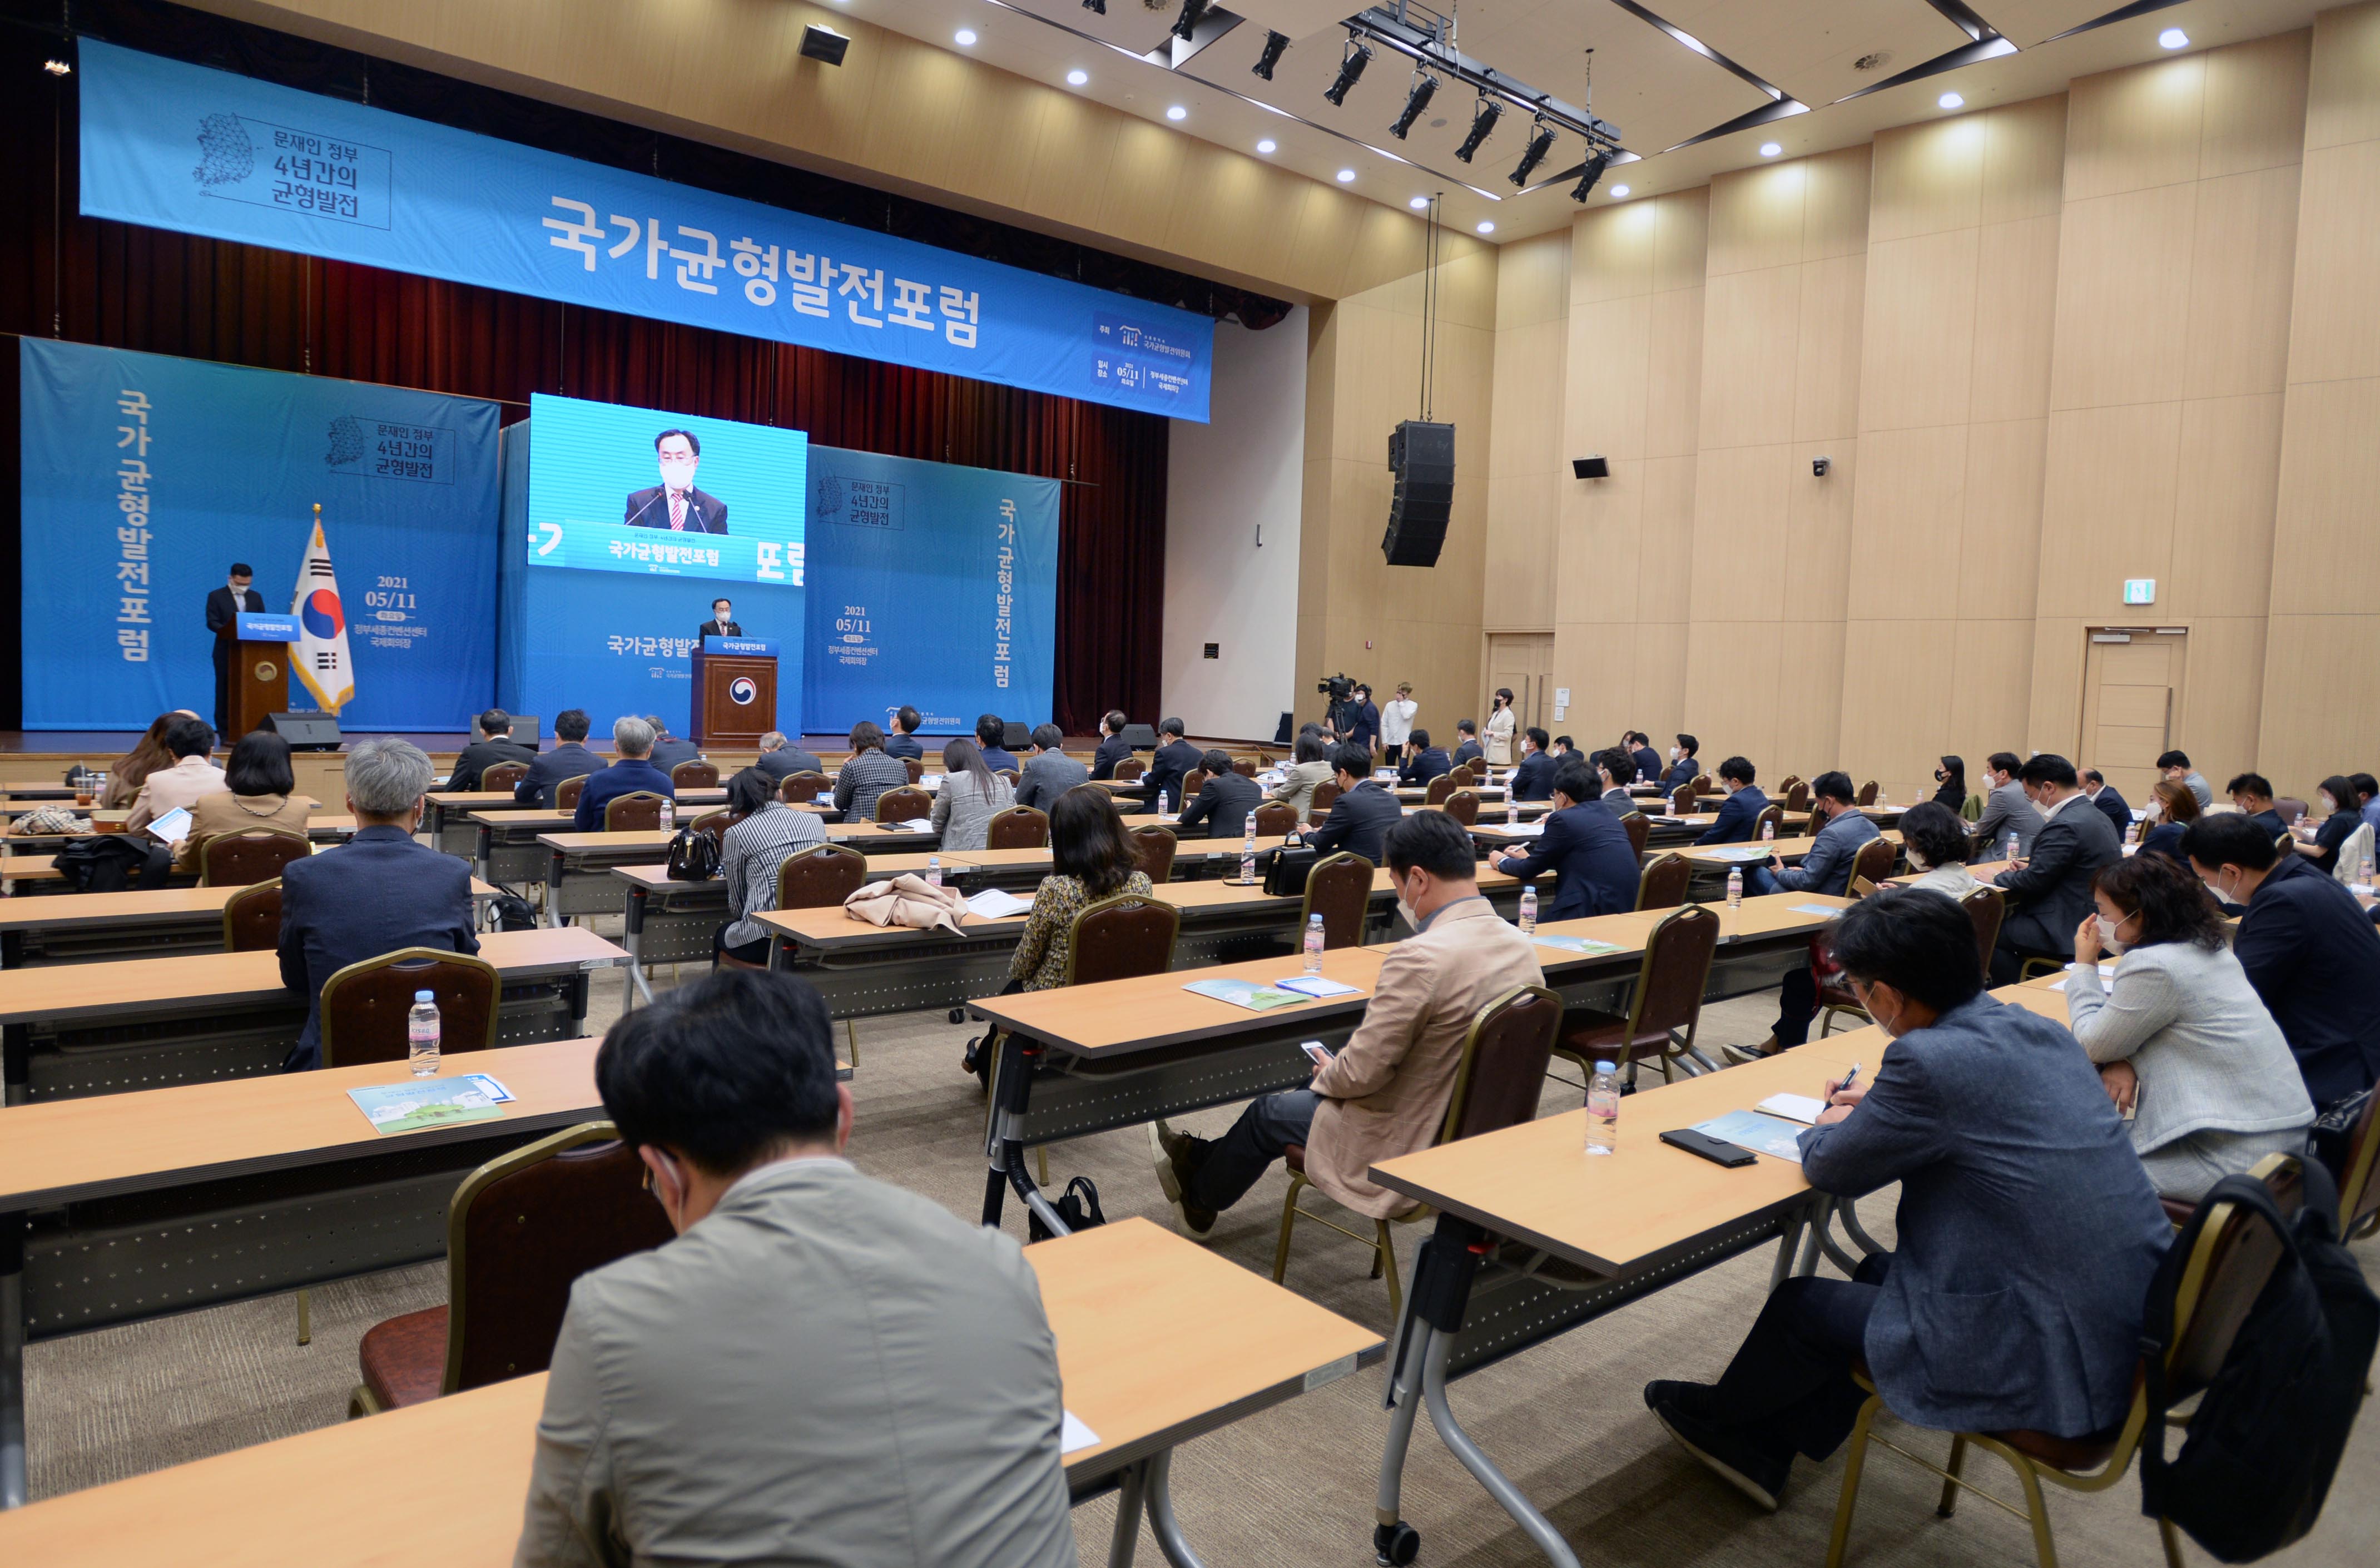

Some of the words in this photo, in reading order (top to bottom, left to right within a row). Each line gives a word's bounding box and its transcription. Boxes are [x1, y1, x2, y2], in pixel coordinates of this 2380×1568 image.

[274, 131, 321, 156] 문재인
[328, 142, 359, 163] 정부
[274, 155, 357, 191] 4년간의
[272, 180, 358, 219] 균형발전
[542, 195, 980, 349] 국가균형발전포럼
[1117, 366, 1139, 380] 05/11
[378, 424, 409, 439] 문재인
[413, 428, 433, 441] 정부
[378, 440, 432, 460] 4년간의
[375, 458, 432, 479] 균형발전
[851, 482, 872, 493] 문재인
[876, 484, 889, 494] 정부
[851, 494, 889, 510] 4년간의
[850, 509, 889, 525] 균형발전
[117, 390, 153, 662] 국가균형발전포럼
[608, 540, 720, 567] 국가균형발전포럼
[377, 575, 408, 589] 2021
[365, 591, 416, 608] 05/11
[994, 498, 1017, 688] 국가균형발전포럼
[844, 606, 865, 616] 2021
[836, 618, 871, 633] 05/11
[921, 716, 961, 726] 균형발전위원회
